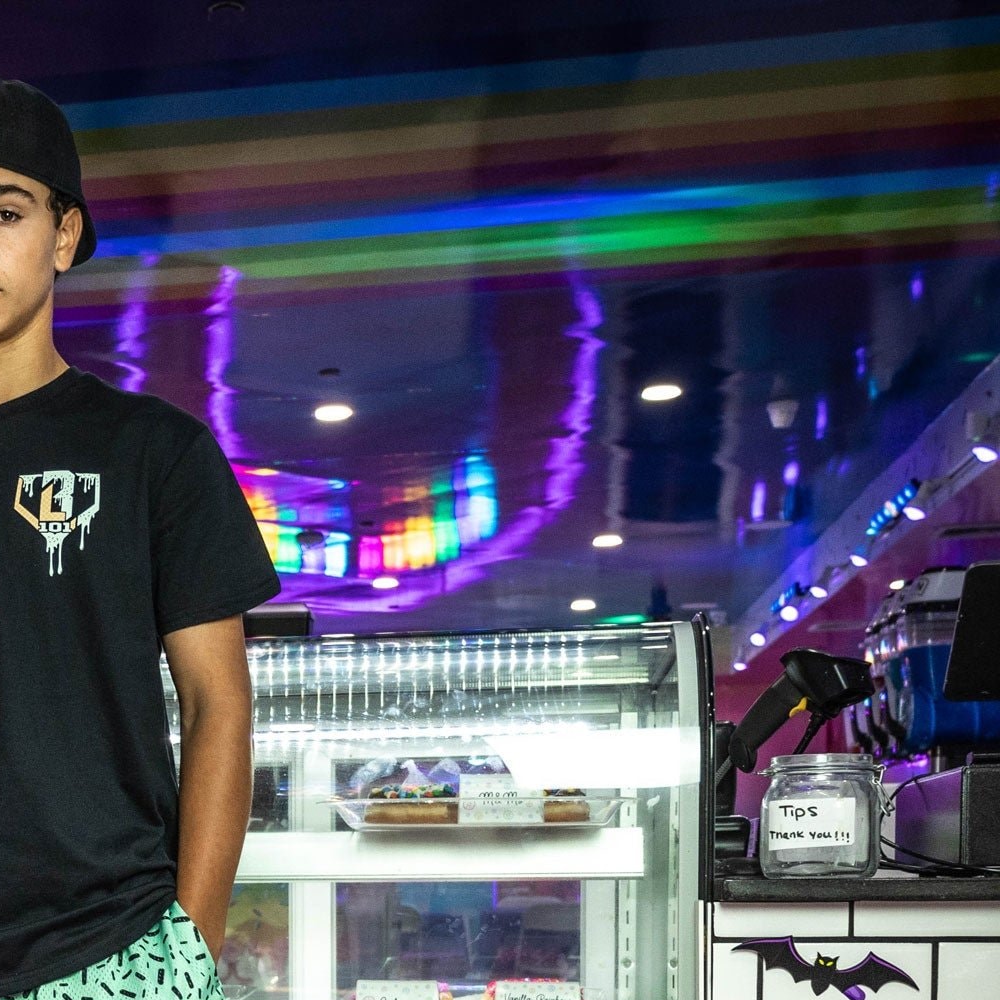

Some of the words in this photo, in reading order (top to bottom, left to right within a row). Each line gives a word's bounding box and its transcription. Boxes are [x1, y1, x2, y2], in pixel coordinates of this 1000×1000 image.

[39, 522, 72, 533] 101
[779, 805, 818, 821] Tips
[769, 831, 804, 840] Thank
